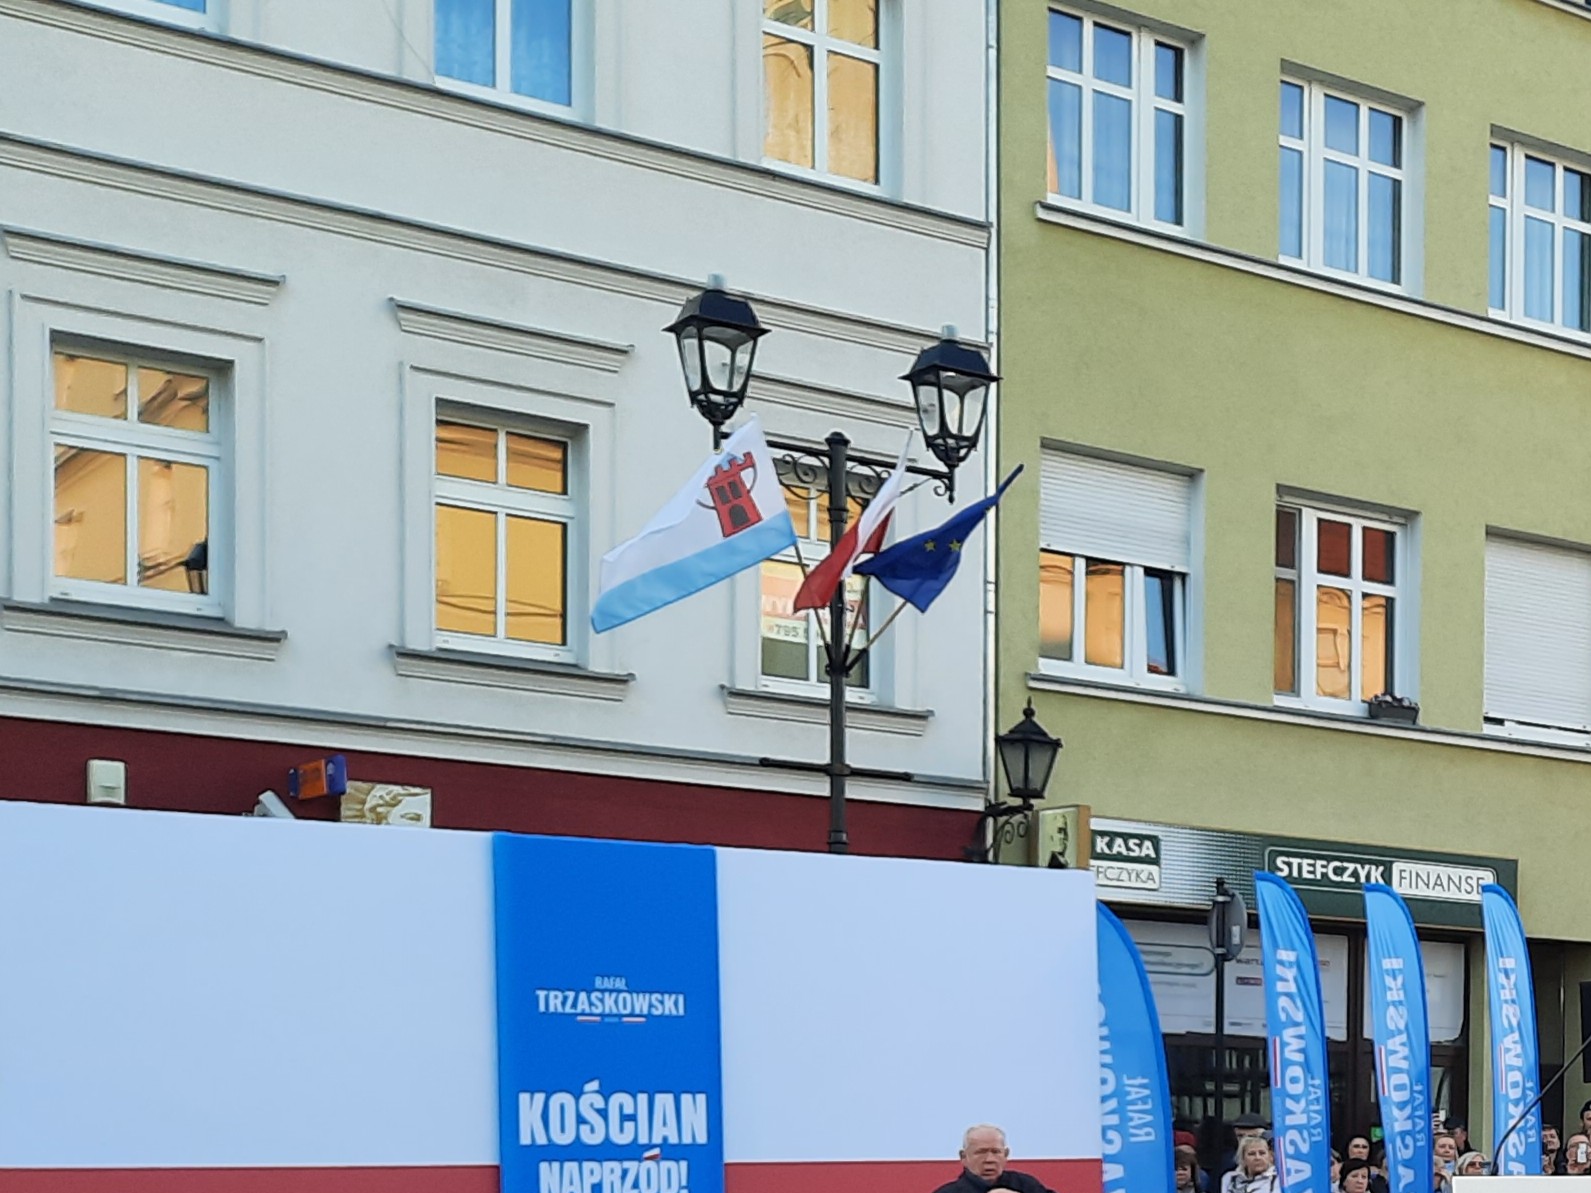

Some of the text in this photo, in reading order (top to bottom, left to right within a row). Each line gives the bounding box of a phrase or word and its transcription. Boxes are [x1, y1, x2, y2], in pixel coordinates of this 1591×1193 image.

[1095, 835, 1156, 858] KASA
[1091, 865, 1157, 884] FCZYKA
[1275, 856, 1385, 884] STEFCZYK
[535, 989, 685, 1017] TRZASKOWSKI
[518, 1079, 709, 1146] KOŚCIAN
